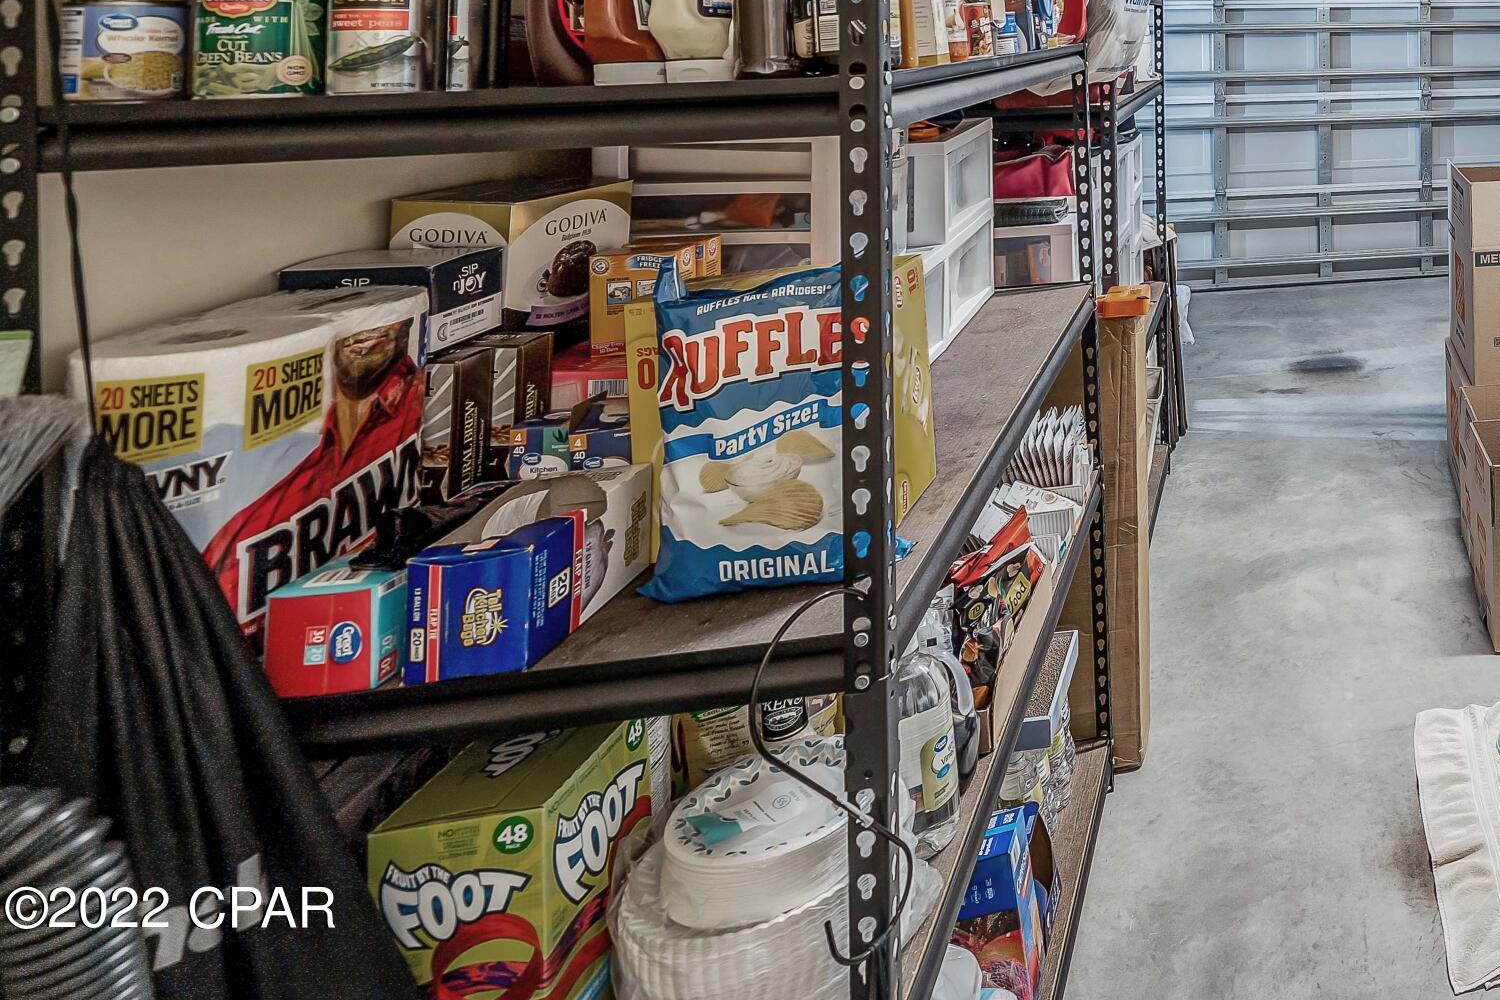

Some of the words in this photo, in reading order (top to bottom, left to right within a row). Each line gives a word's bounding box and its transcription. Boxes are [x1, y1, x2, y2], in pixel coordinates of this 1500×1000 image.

[217, 39, 249, 52] CUT
[234, 51, 283, 64] BEANS
[545, 208, 608, 237] GODIVA
[408, 227, 488, 244] GODIVA
[461, 263, 479, 277] SIP
[341, 278, 371, 288] SIP
[696, 296, 741, 315] RUFFLES
[660, 311, 842, 406] RUFFLE
[252, 366, 277, 391] 20
[281, 352, 323, 384] SHEETS
[100, 387, 125, 411] 20
[130, 379, 198, 409] SHEETS
[250, 376, 322, 435] MORE
[101, 406, 197, 453] MORE
[463, 400, 475, 443] BREW
[714, 423, 768, 458] Party
[771, 402, 819, 437] Size!
[514, 433, 522, 442] 4
[574, 438, 582, 447] 4
[513, 446, 525, 454] 40
[572, 451, 586, 459] 40
[529, 466, 558, 474] Kitchen
[239, 436, 421, 621] BRAW
[573, 548, 583, 577] FLAP
[719, 551, 836, 582] ORIGINAL
[556, 571, 568, 598] 20
[572, 578, 582, 598] TIE
[413, 596, 422, 622] GALLON
[487, 588, 503, 612] Tall
[430, 607, 439, 625] FLAP
[473, 595, 490, 644] Kitchen
[312, 628, 325, 644] 30
[342, 626, 355, 657] Great
[412, 632, 422, 646] 20
[428, 626, 438, 640] TIE
[461, 614, 475, 647] Bags
[627, 719, 643, 743] 48
[558, 816, 581, 839] FRUIT
[579, 805, 590, 825] BY
[588, 793, 601, 811] THE
[496, 823, 529, 844] 48
[555, 762, 647, 902] FOOT
[385, 863, 416, 886] FRUIT
[416, 865, 431, 885] BY
[430, 866, 451, 885] THE
[381, 871, 529, 949] FOOT
